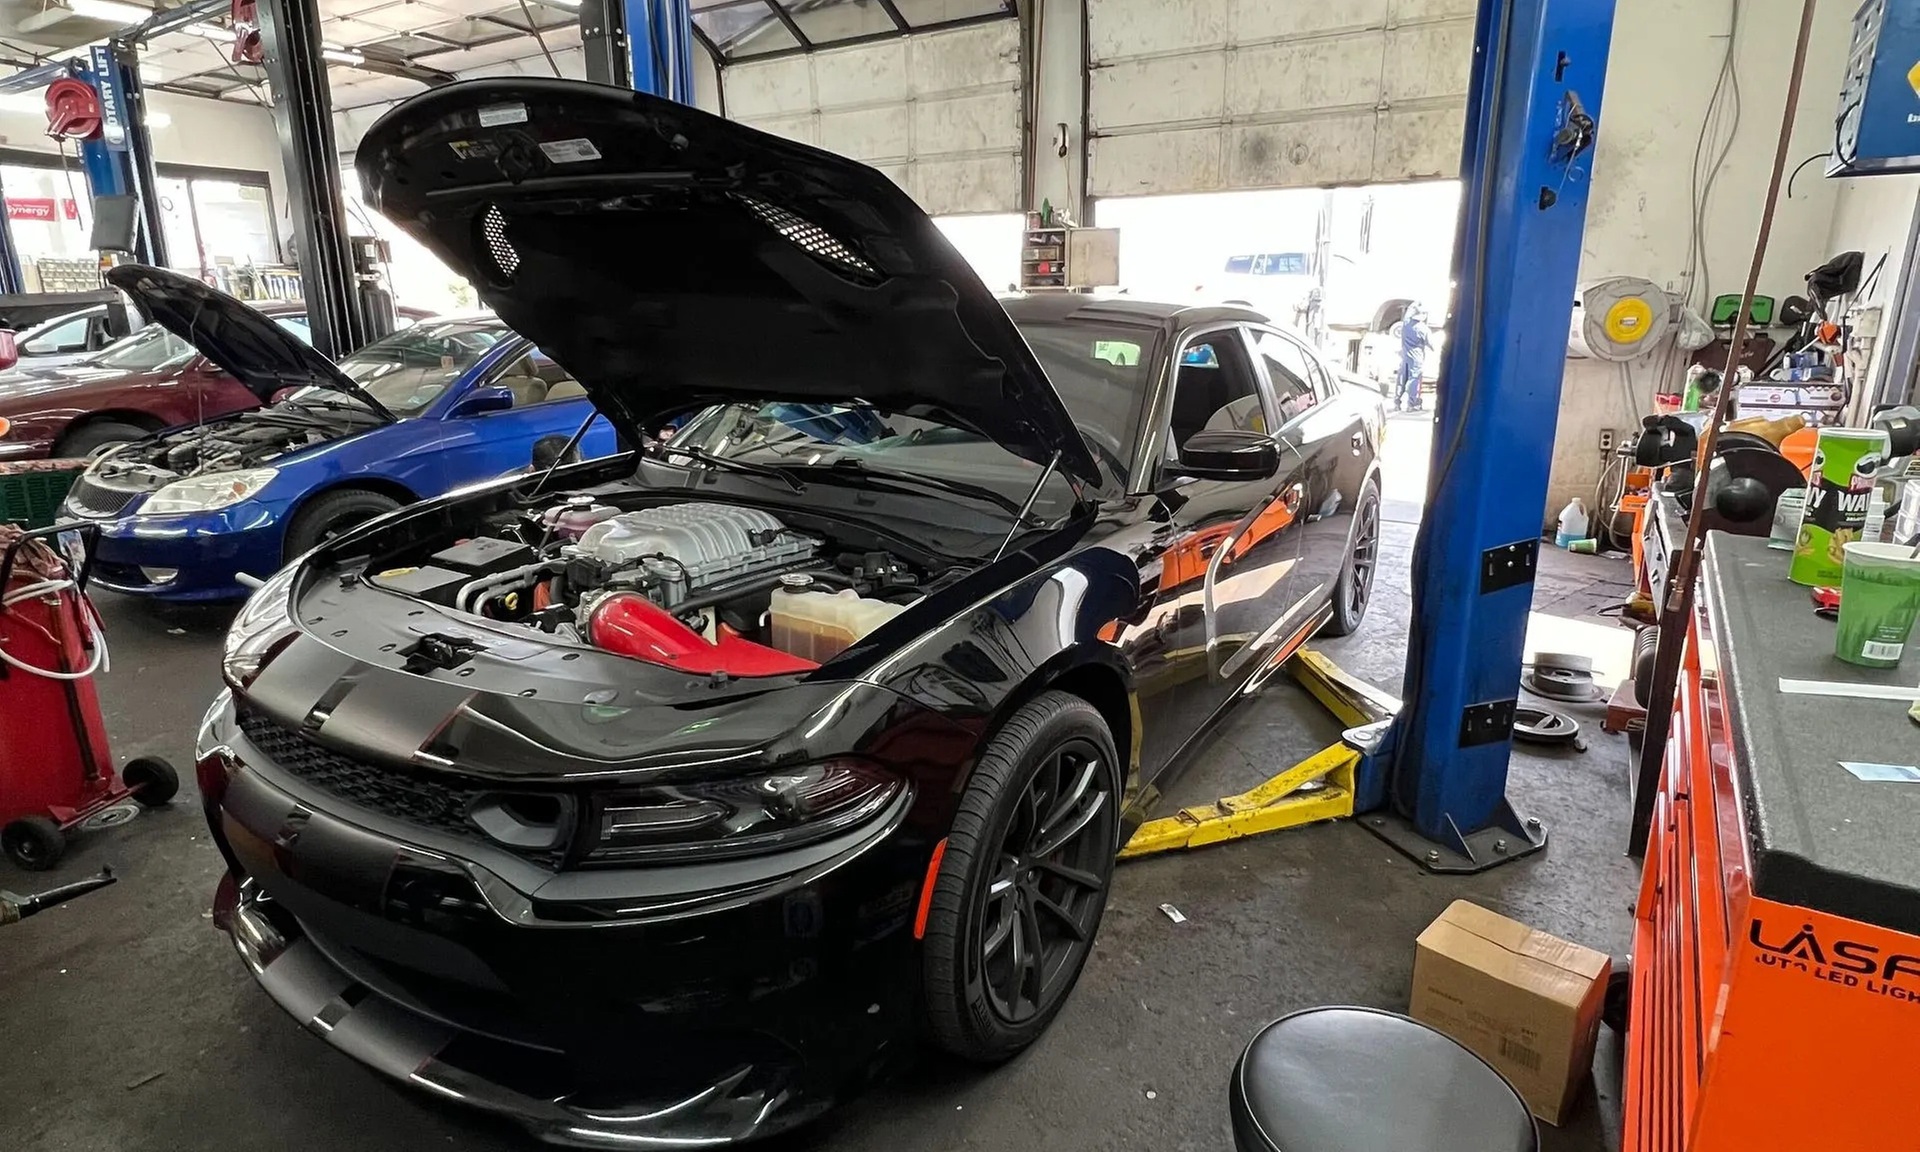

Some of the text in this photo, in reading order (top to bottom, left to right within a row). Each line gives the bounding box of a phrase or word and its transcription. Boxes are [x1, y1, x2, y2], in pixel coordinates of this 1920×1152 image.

[95, 47, 119, 133] OTARY LIFT
[1814, 967, 1859, 987] LED
